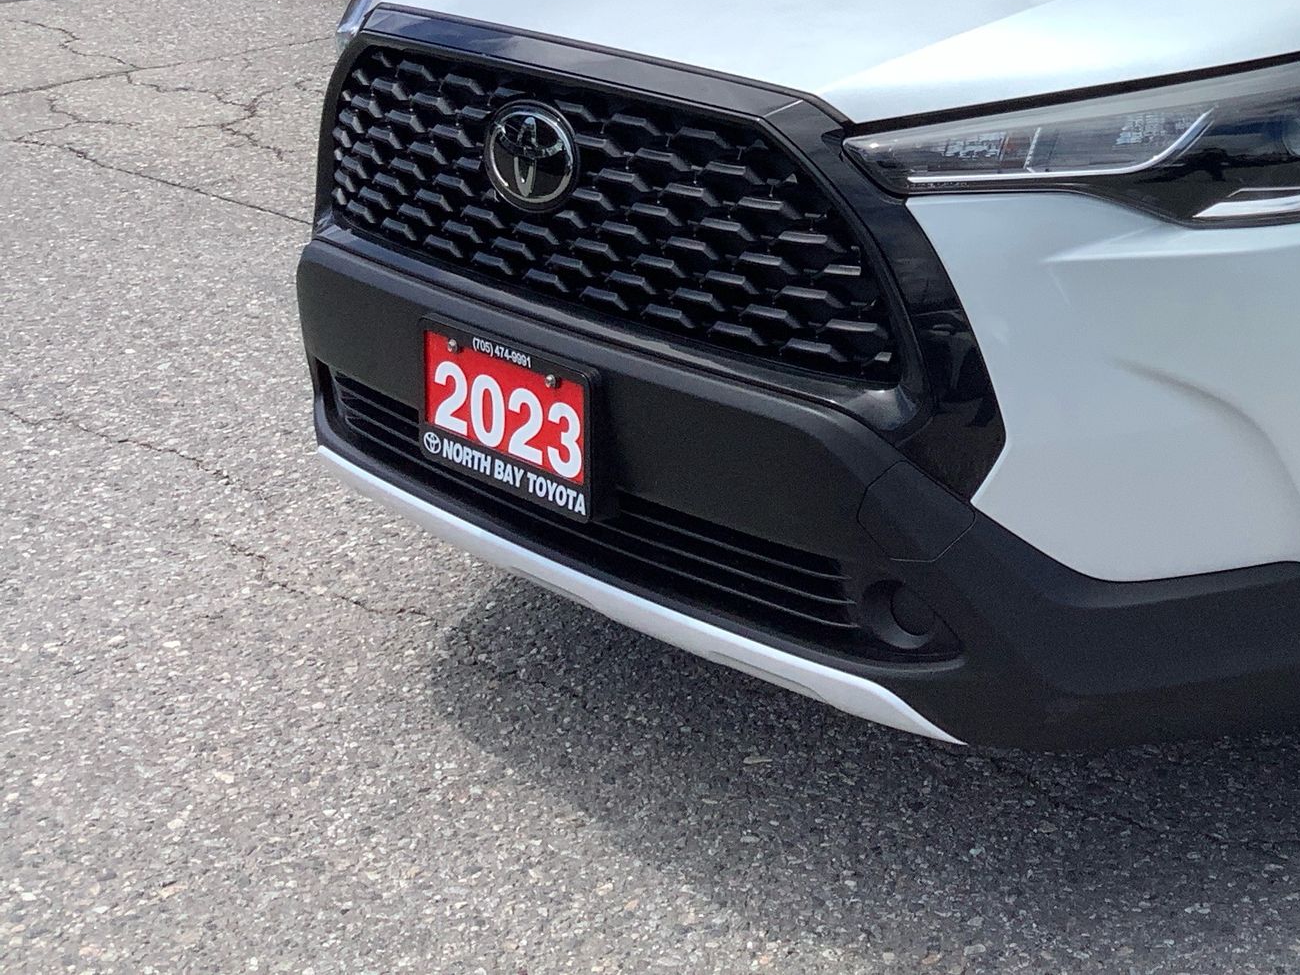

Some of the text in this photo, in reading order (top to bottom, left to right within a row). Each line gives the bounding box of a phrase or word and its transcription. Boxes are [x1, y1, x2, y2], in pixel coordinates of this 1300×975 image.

[472, 336, 494, 358] (705)
[433, 360, 583, 479] 2023
[442, 438, 587, 516] NORTH BAY TOYOTA
